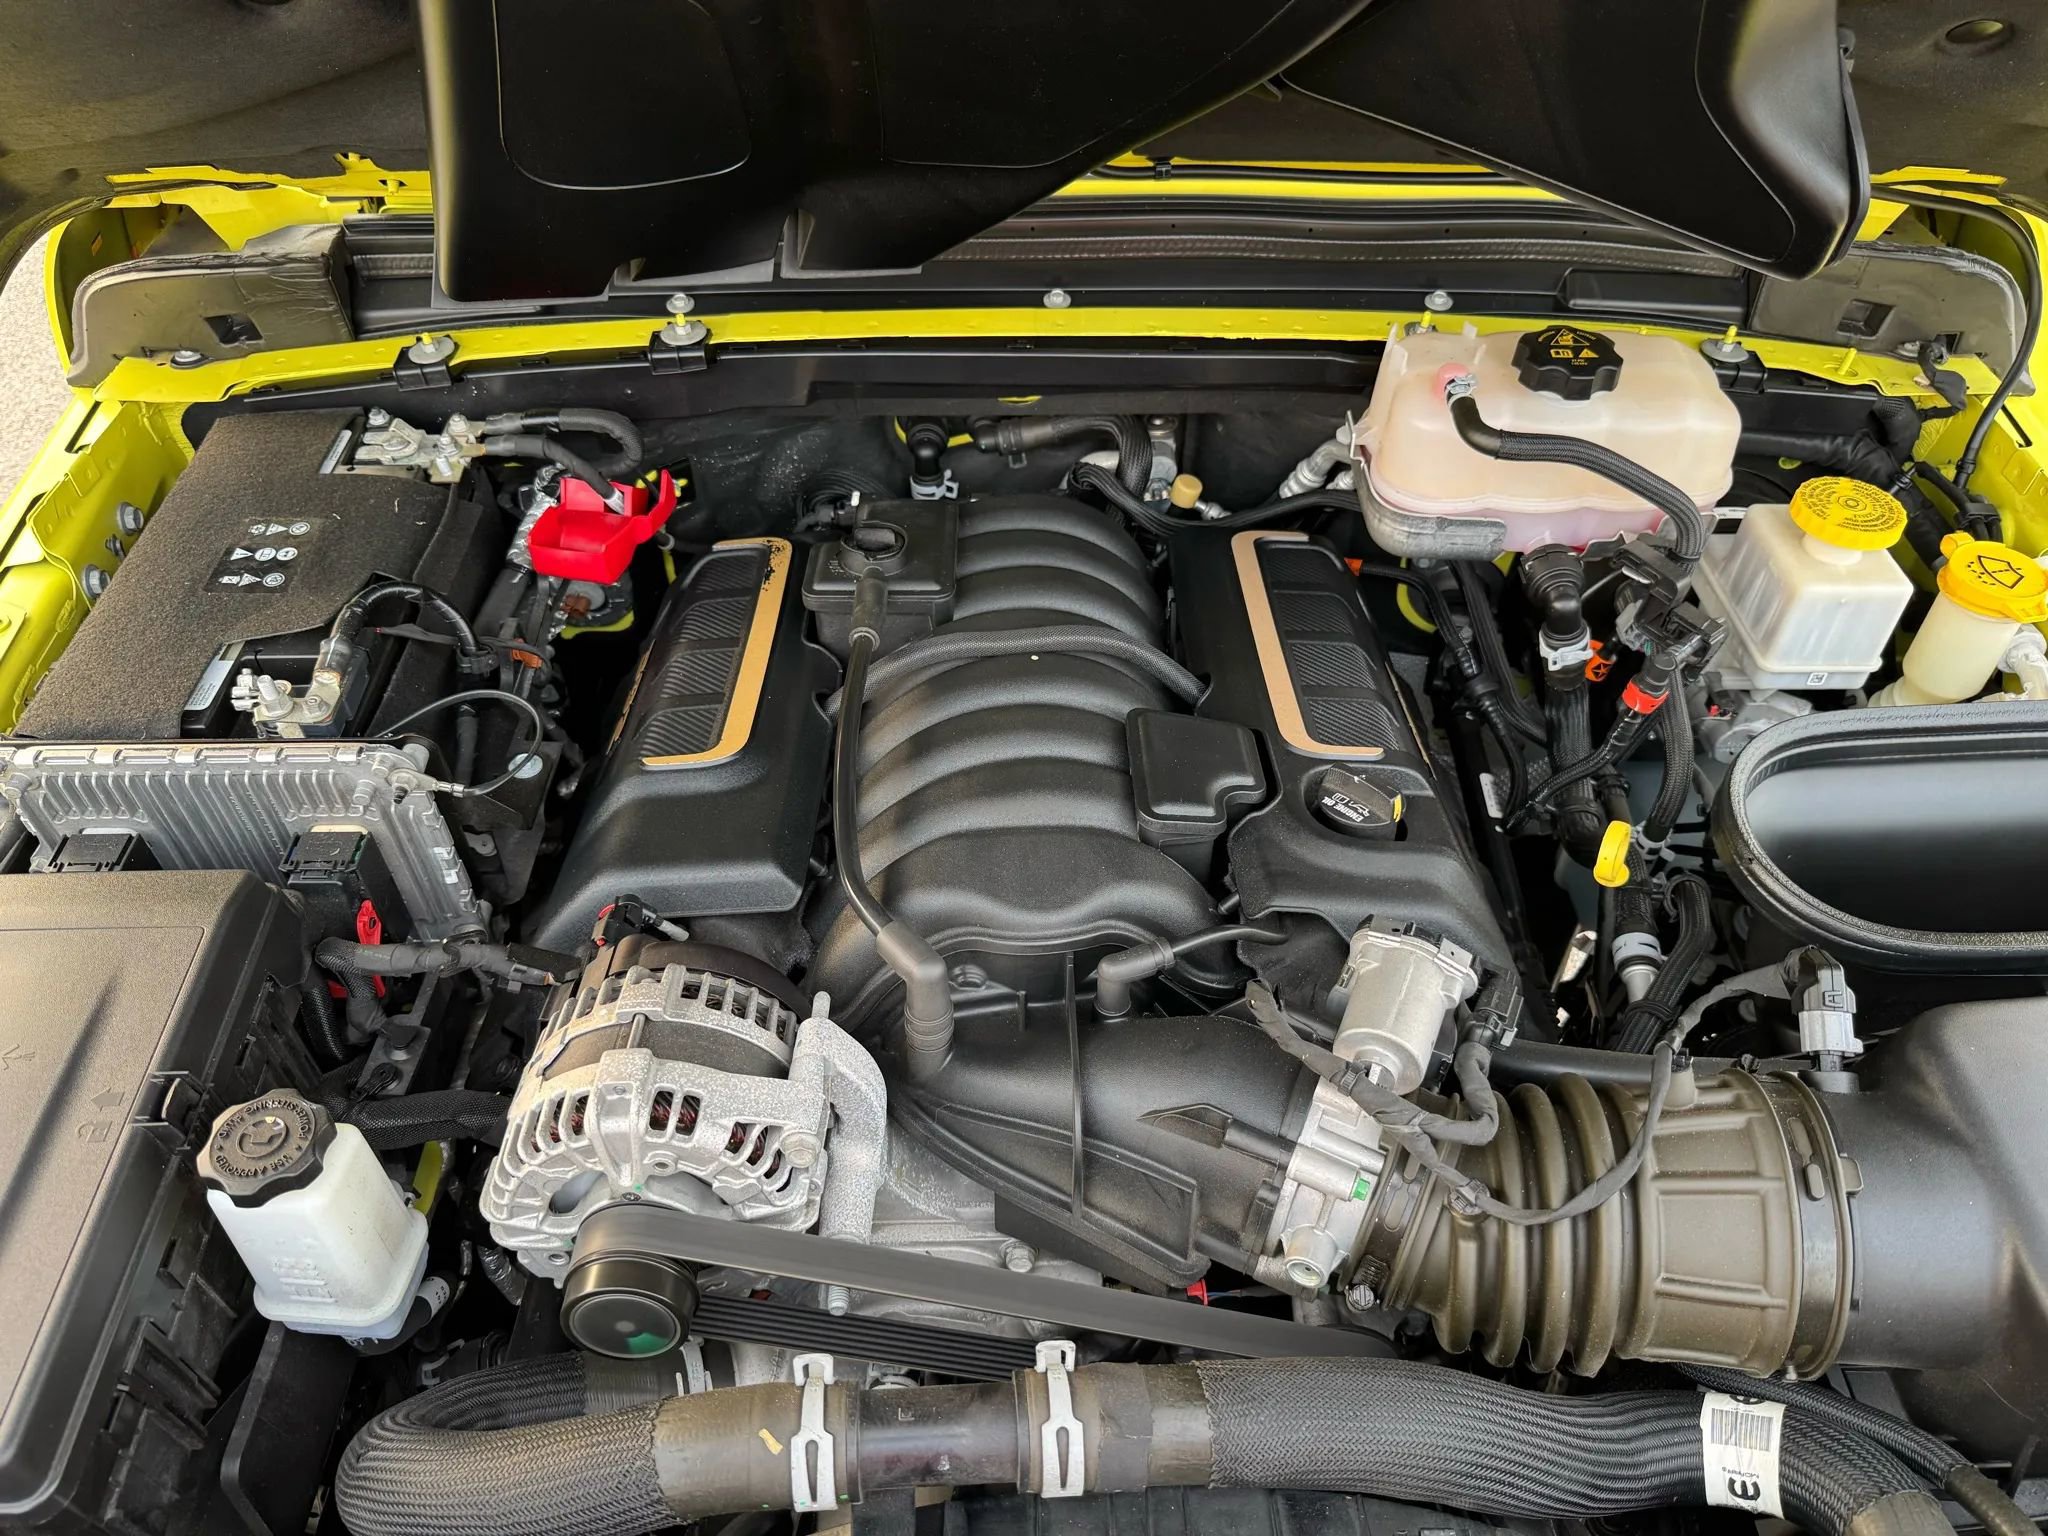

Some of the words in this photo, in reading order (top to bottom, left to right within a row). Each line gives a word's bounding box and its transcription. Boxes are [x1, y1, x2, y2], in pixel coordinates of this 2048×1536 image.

[1321, 796, 1335, 806] OIL
[1333, 803, 1364, 822] ENGINE
[294, 1106, 311, 1138] POWER
[215, 1155, 268, 1177] APPROVED
